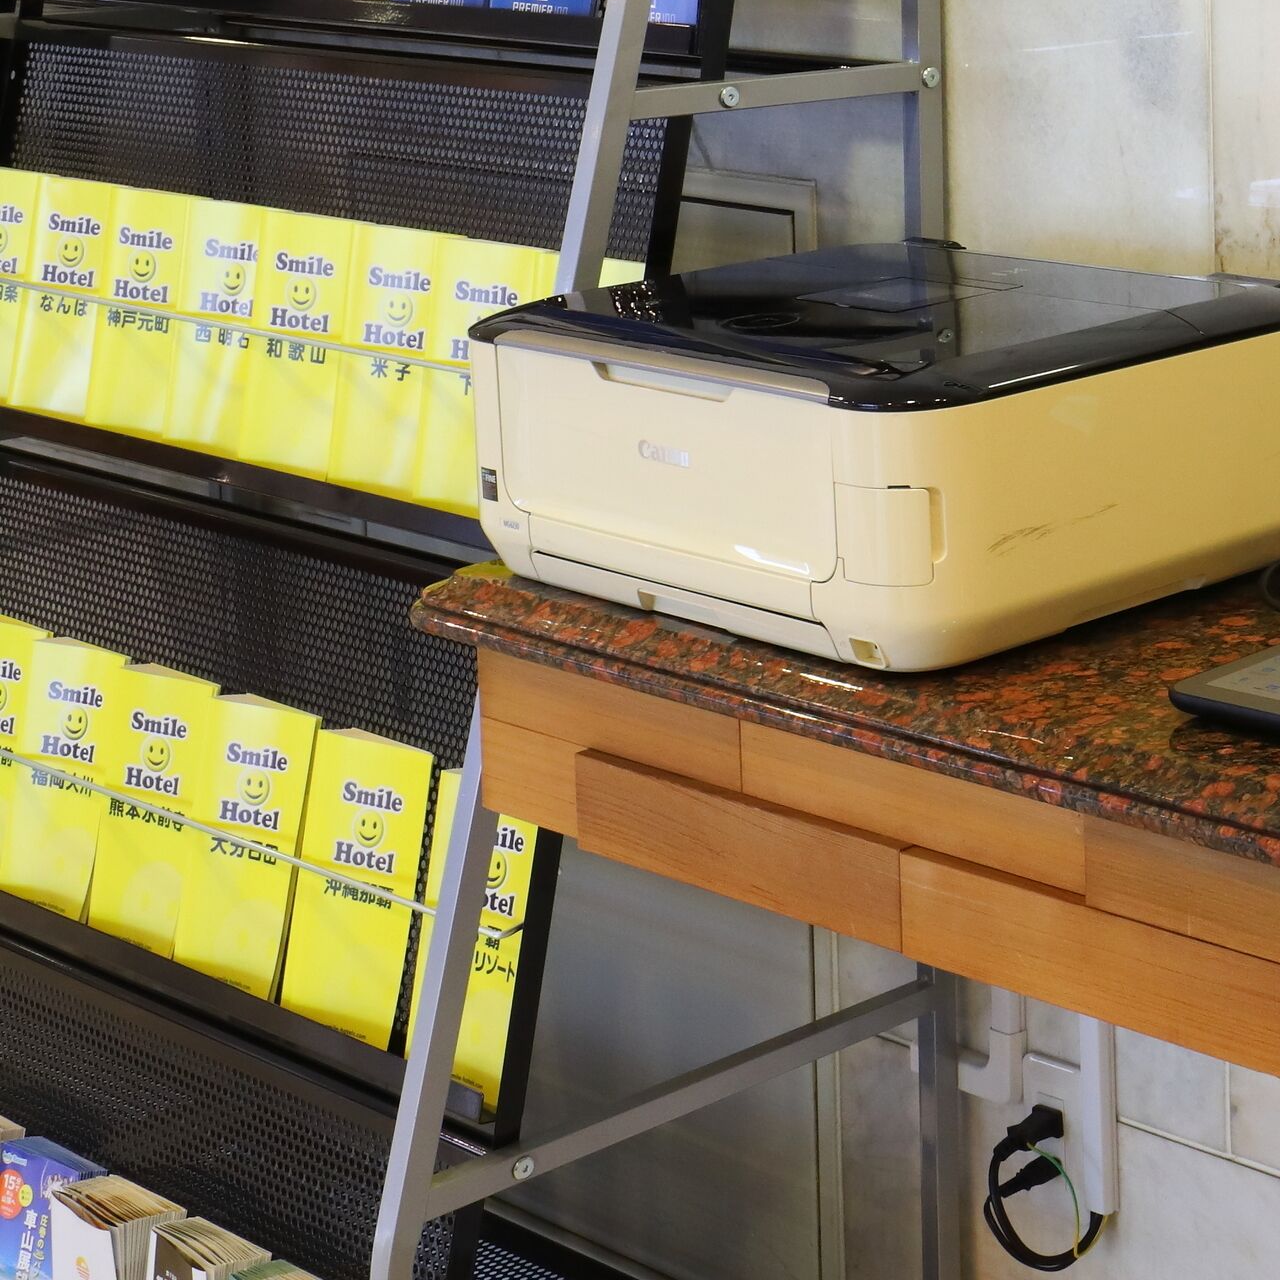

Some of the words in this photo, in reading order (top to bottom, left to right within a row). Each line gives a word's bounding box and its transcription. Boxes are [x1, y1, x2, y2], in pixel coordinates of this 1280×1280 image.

[1, 206, 24, 224] ile
[48, 213, 101, 236] Smile
[119, 226, 173, 250] Smile
[204, 238, 259, 262] Smile
[41, 264, 95, 288] Hotel
[275, 252, 335, 277] Smile
[113, 279, 168, 303] Hotel
[368, 266, 432, 292] Smile
[200, 292, 254, 318] Hotel
[455, 280, 518, 307] Smile
[107, 307, 171, 334] 神戸元町
[269, 307, 330, 333] Hotel
[362, 323, 425, 350] Hotel
[266, 338, 327, 365] 和歌山
[370, 357, 411, 382] 米子
[638, 439, 690, 468] Cann
[1, 661, 21, 681] ile
[48, 681, 103, 708] Smile
[131, 711, 187, 739] Smile
[41, 735, 95, 763] Hotel
[226, 742, 288, 771] Smile
[125, 766, 180, 796] Hotel
[342, 781, 403, 812] Smile
[219, 800, 280, 830] Hotel
[496, 827, 524, 853] ile
[333, 840, 395, 874] Hotel
[474, 950, 515, 983] リゾート
[4, 1174, 16, 1191] 15
